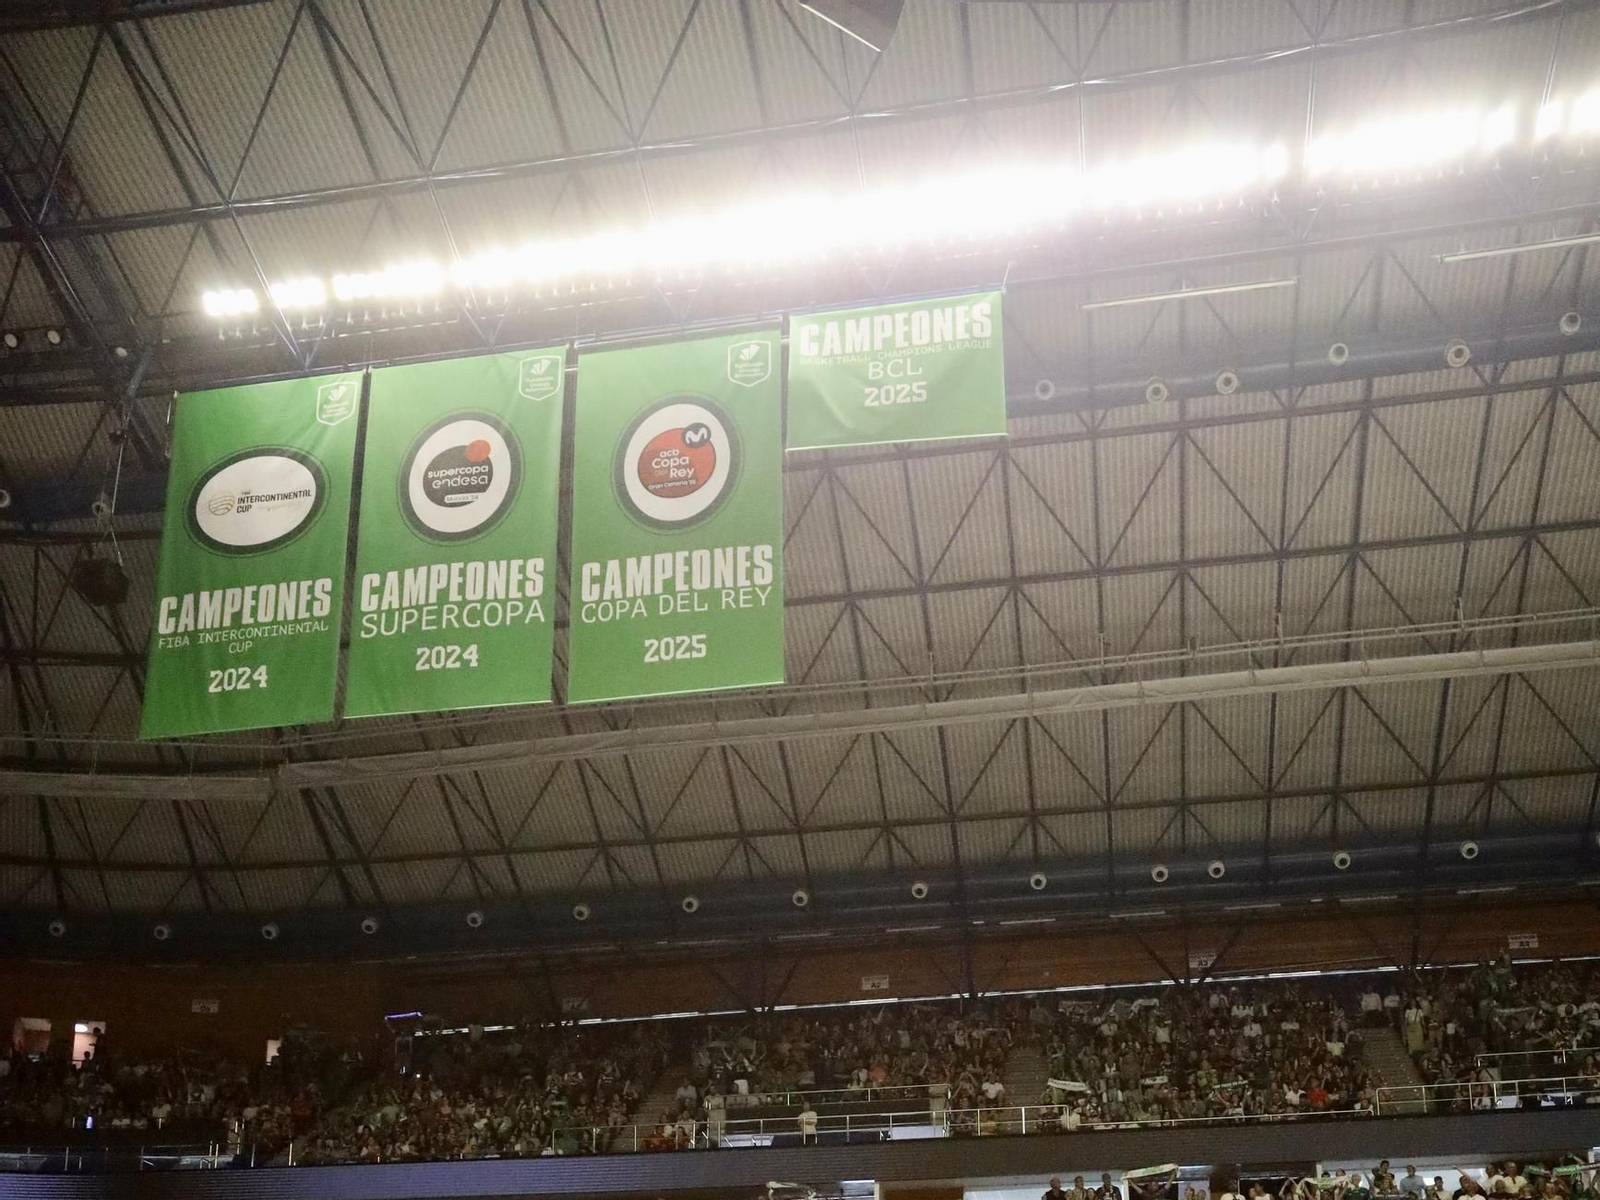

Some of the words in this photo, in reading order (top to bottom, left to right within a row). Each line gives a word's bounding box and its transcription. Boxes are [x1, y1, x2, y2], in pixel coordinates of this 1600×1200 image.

[800, 302, 992, 358] CAMPEONES
[799, 354, 871, 366] BASKETBALL
[877, 344, 943, 360] CHAMPIONS
[949, 339, 994, 350] LEAGUE
[868, 358, 924, 380] BCL
[863, 381, 928, 407] 2025
[651, 456, 690, 468] Copa
[659, 449, 680, 458] acb
[427, 465, 489, 479] supercopa
[432, 475, 489, 489] endesa
[670, 467, 695, 478] Rey
[236, 504, 253, 514] CUP
[237, 489, 312, 505] INTERCONTINENTAL
[360, 557, 545, 613] CAMPEONES
[580, 543, 773, 602] CAMPEONES
[158, 577, 332, 635] CAMPEONES
[580, 595, 648, 623] COPA
[659, 591, 708, 616] DEL
[721, 585, 773, 611] REY
[360, 599, 545, 639] SUPERCOPA
[158, 634, 191, 650] FIBA
[196, 619, 330, 645] INTERCONTINENTAL
[228, 640, 254, 654] CUP
[415, 644, 479, 671] 2024
[643, 634, 707, 663] 2025
[208, 665, 268, 693] 2024
